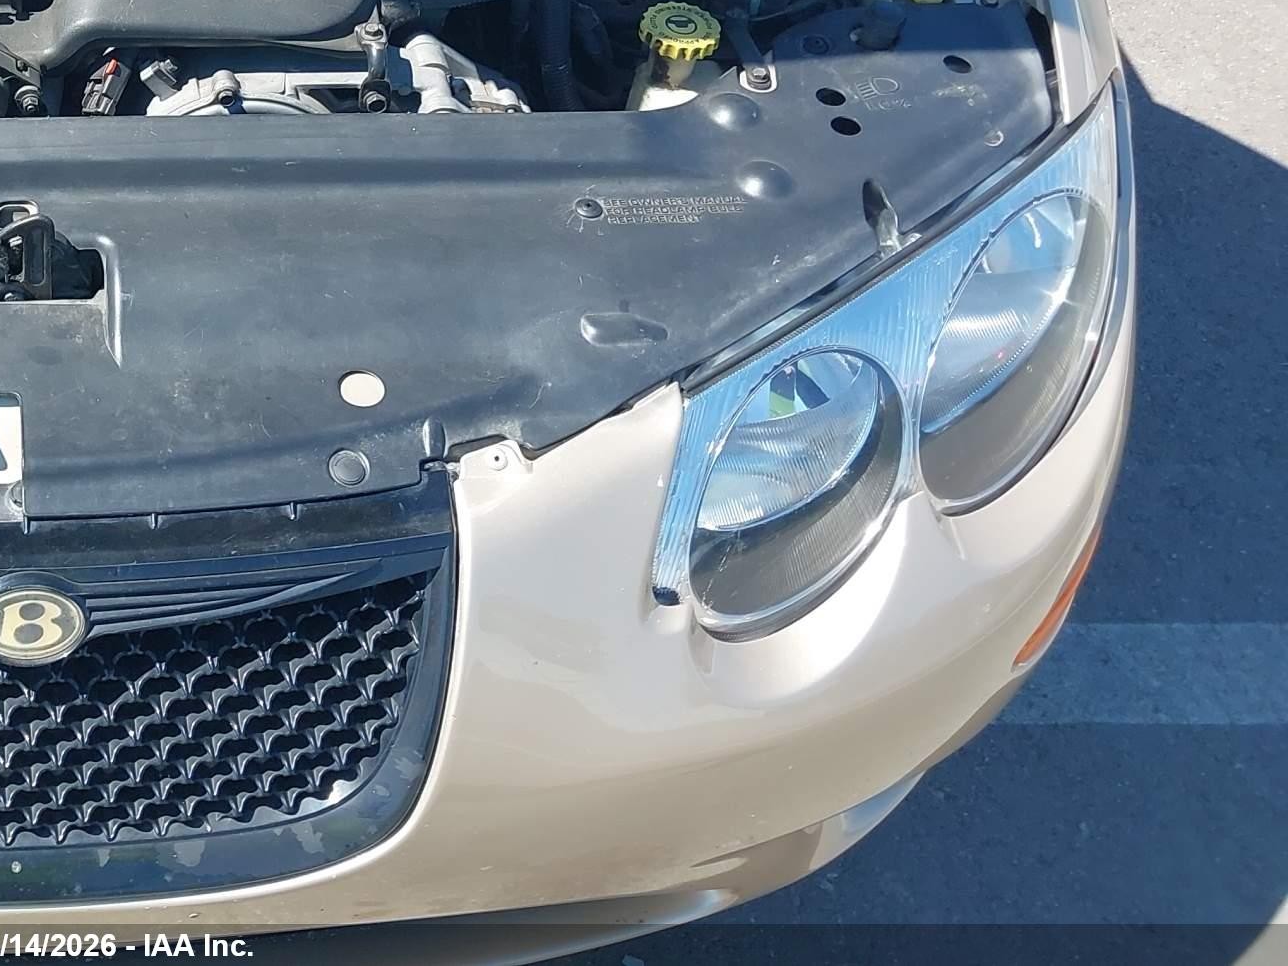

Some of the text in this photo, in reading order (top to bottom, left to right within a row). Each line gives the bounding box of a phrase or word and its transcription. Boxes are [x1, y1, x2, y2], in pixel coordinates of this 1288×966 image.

[691, 195, 747, 204] MANUAL
[605, 207, 630, 215] FOR
[632, 205, 706, 215] HEADLAMP
